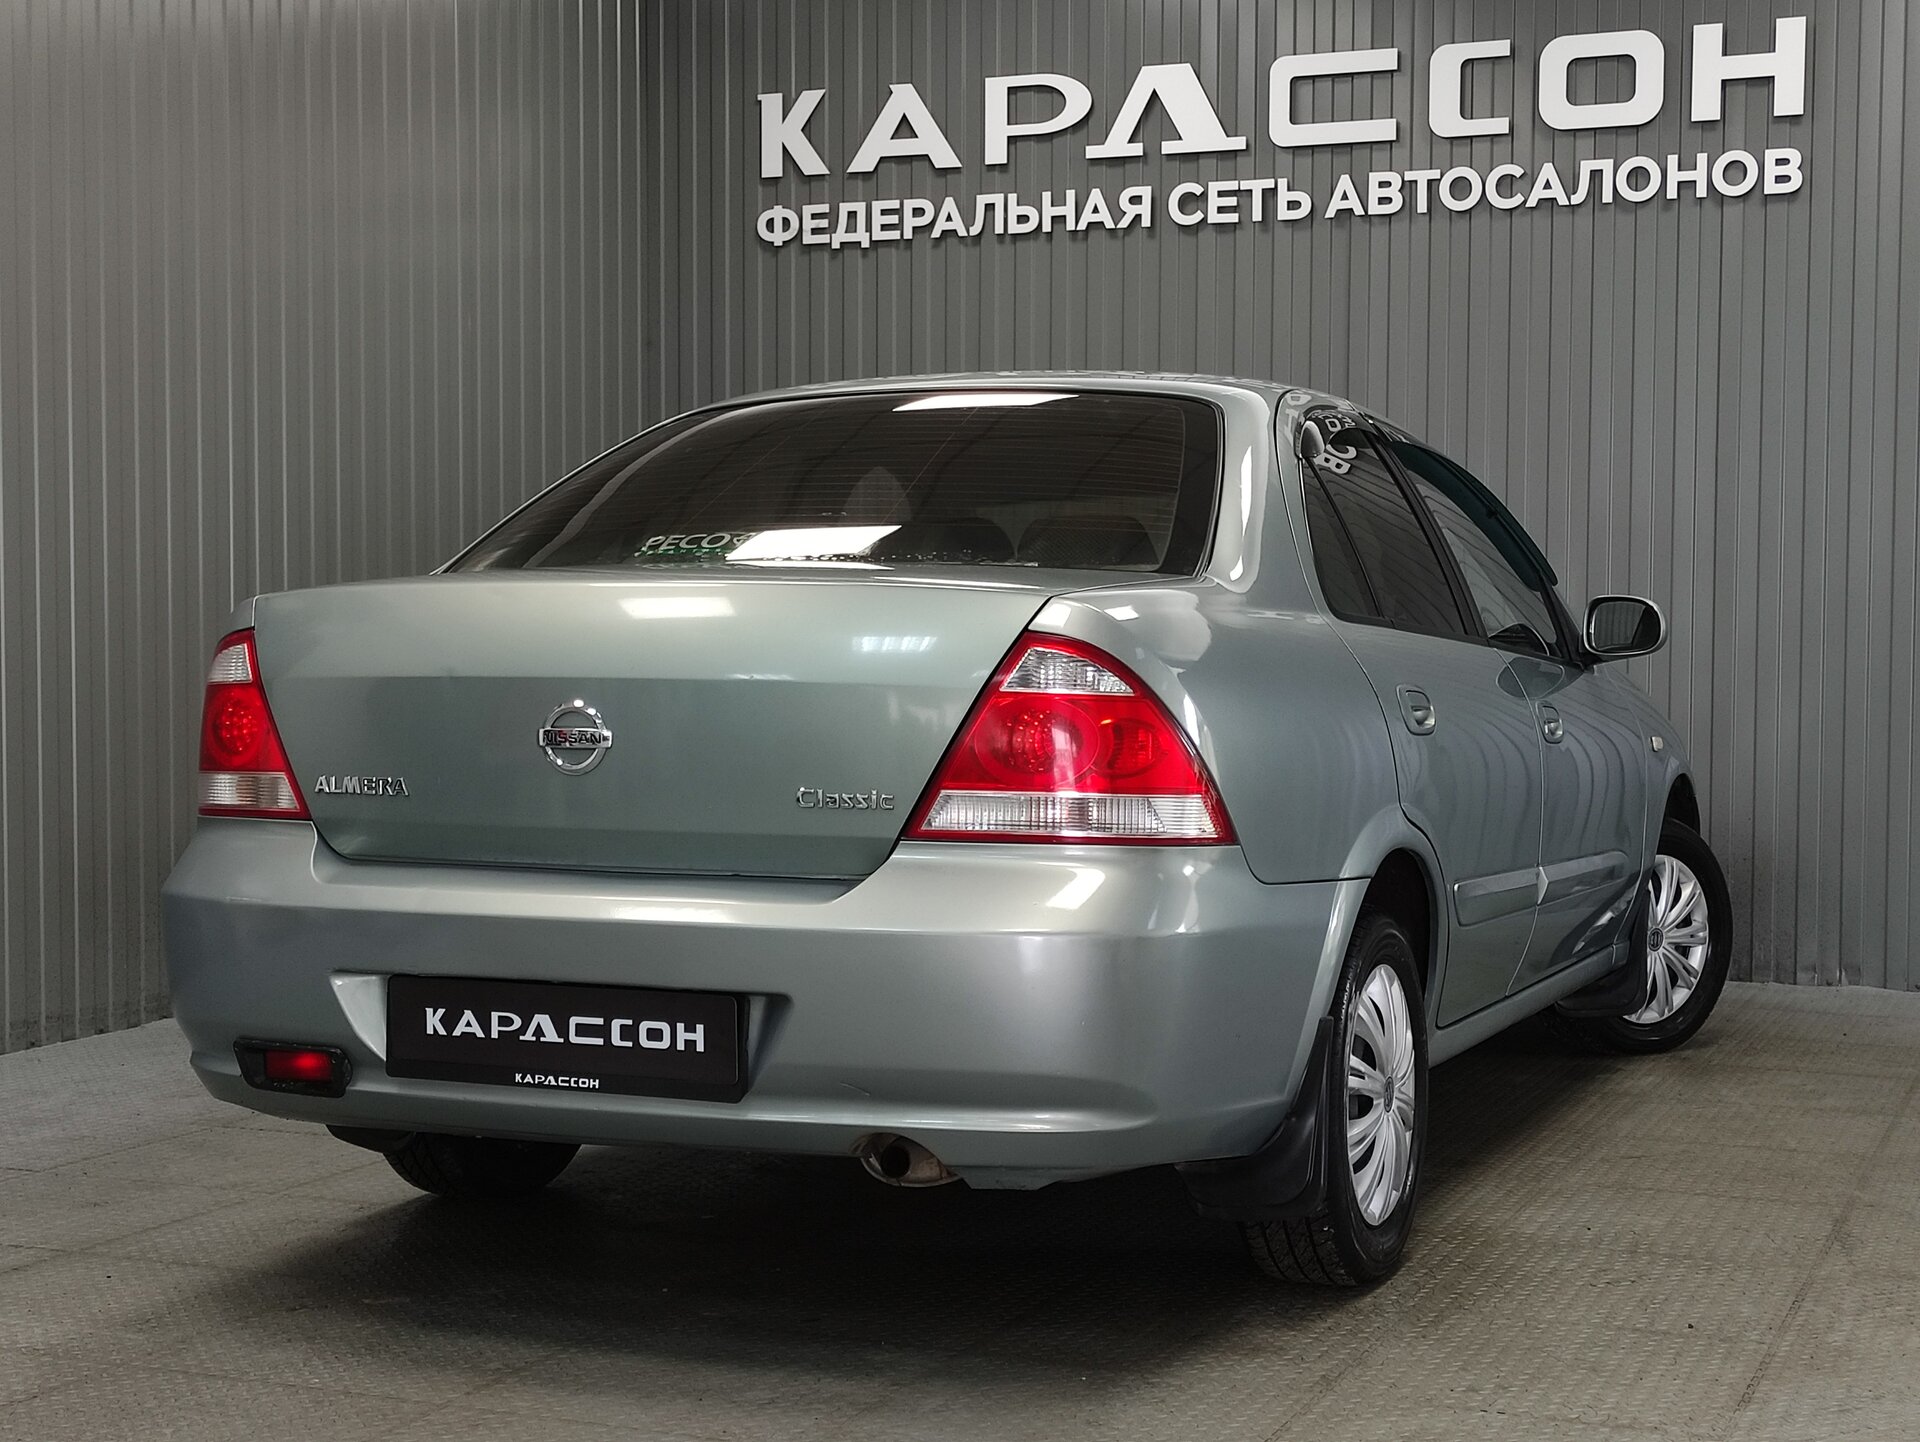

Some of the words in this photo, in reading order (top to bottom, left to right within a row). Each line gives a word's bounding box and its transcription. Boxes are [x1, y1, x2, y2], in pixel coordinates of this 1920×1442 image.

[756, 185, 1152, 249] ФЕДЕРАЛЬНАЯ
[1168, 177, 1312, 226] СЕТЬ
[1324, 147, 1803, 219] АВТОСАЛОНОВ
[543, 730, 603, 746] NISSAN
[314, 775, 410, 796] ALMERA
[796, 786, 895, 810] Classic
